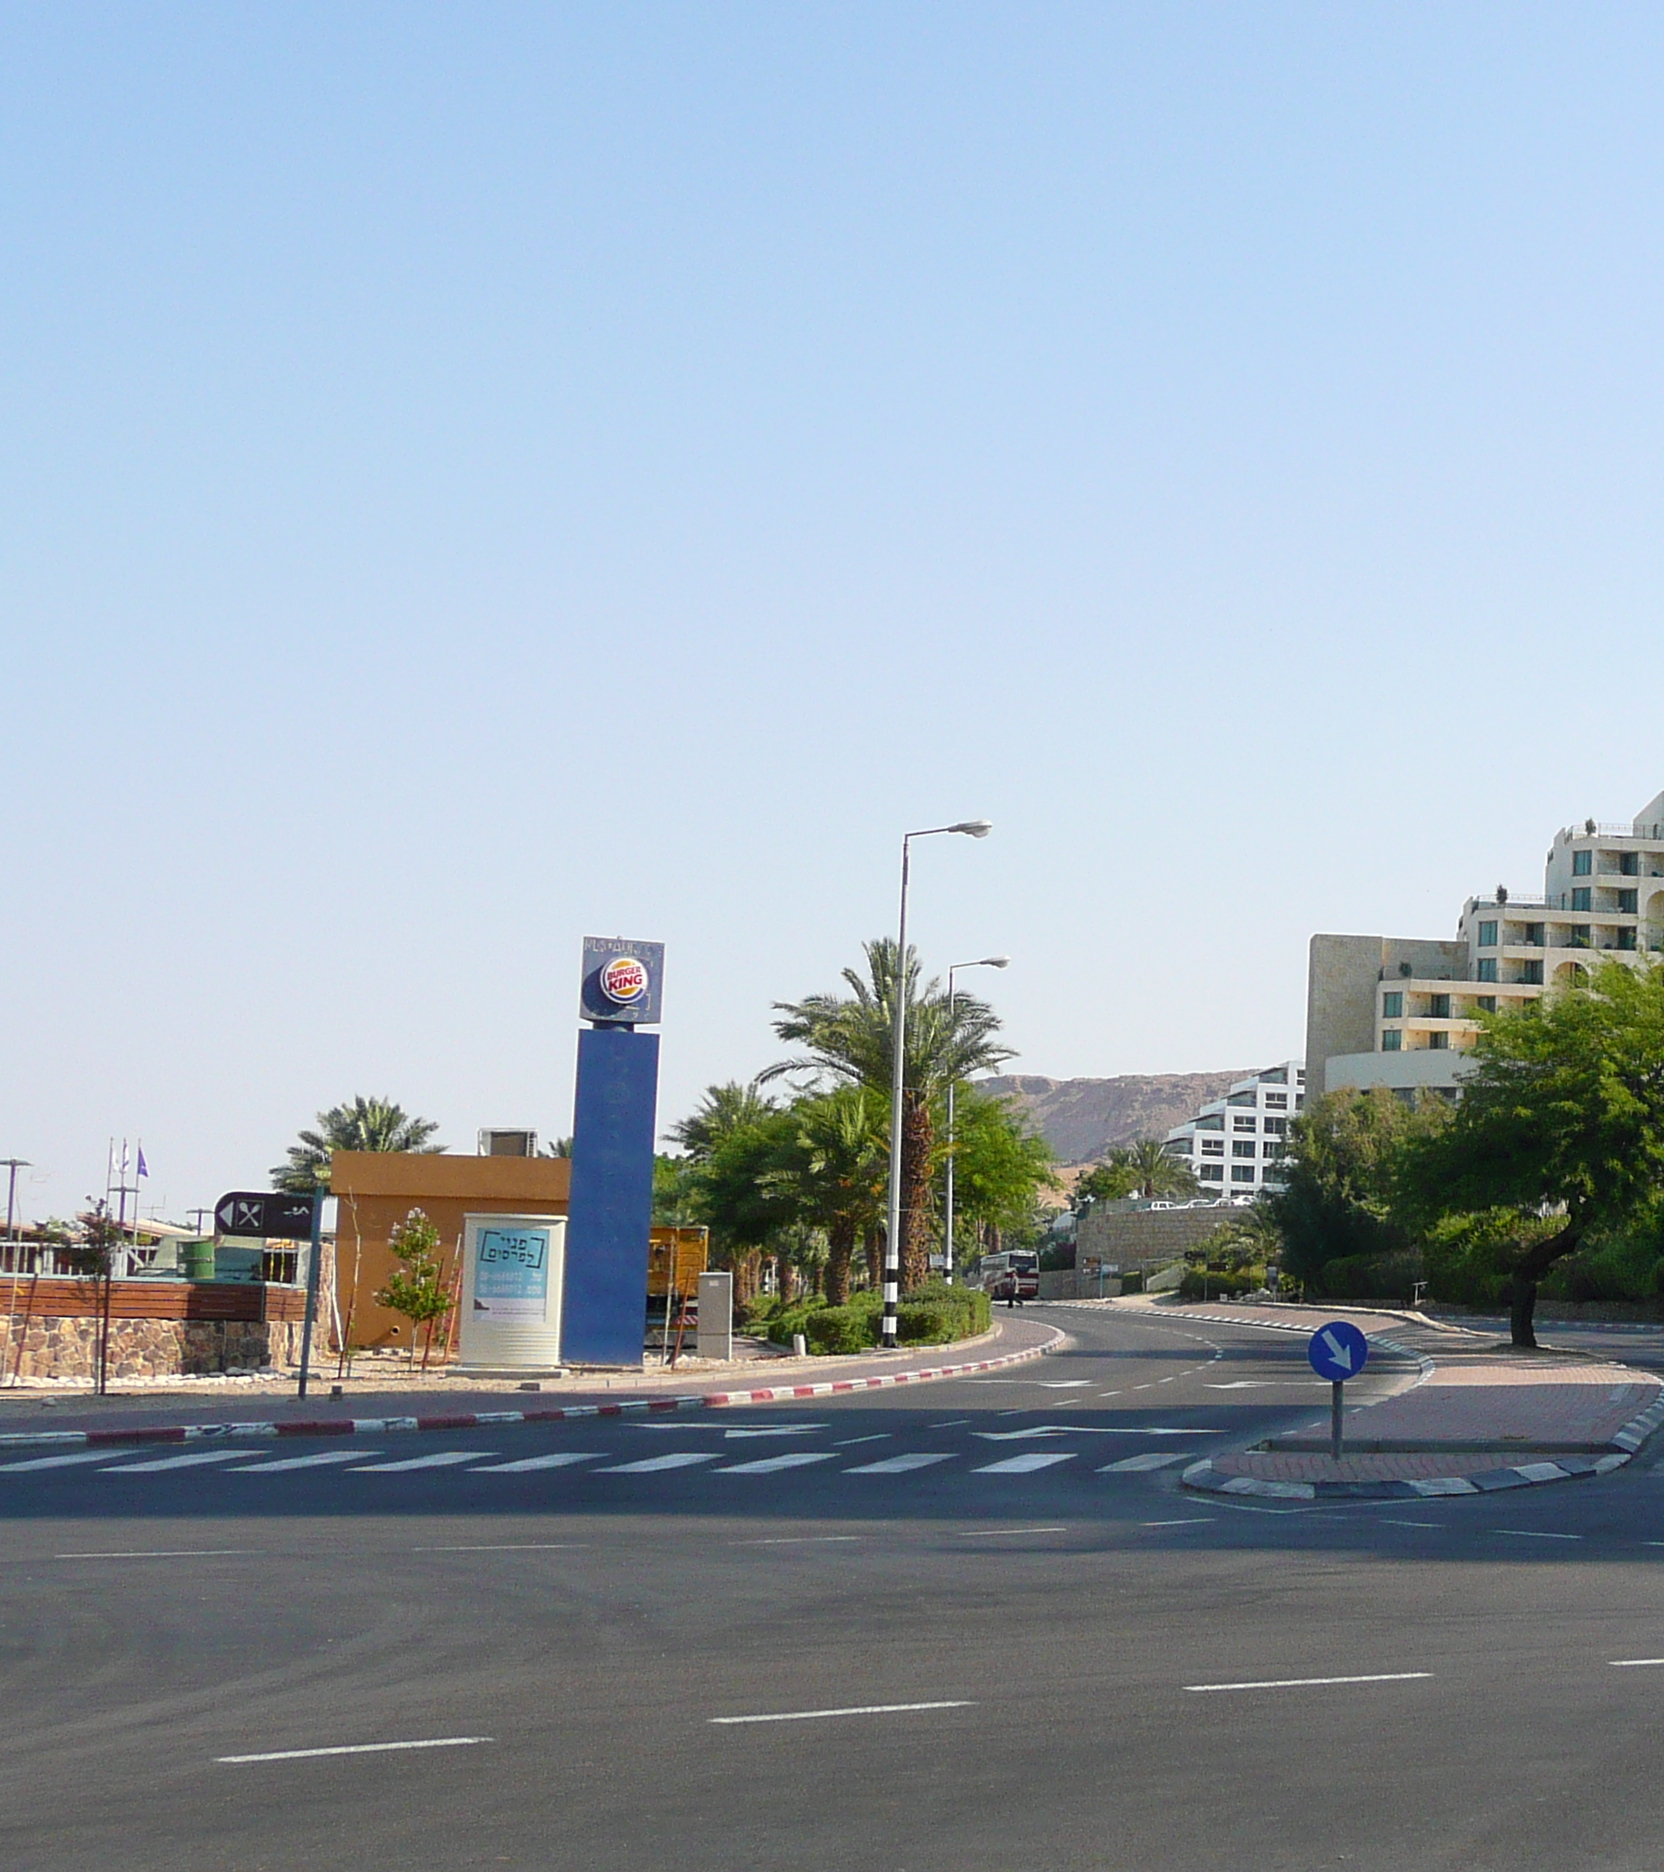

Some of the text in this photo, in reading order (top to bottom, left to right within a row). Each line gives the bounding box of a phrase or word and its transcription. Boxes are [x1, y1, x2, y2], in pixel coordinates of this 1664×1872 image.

[607, 966, 642, 981] BURGER
[608, 974, 643, 992] KING
[500, 1236, 527, 1250] פנוי
